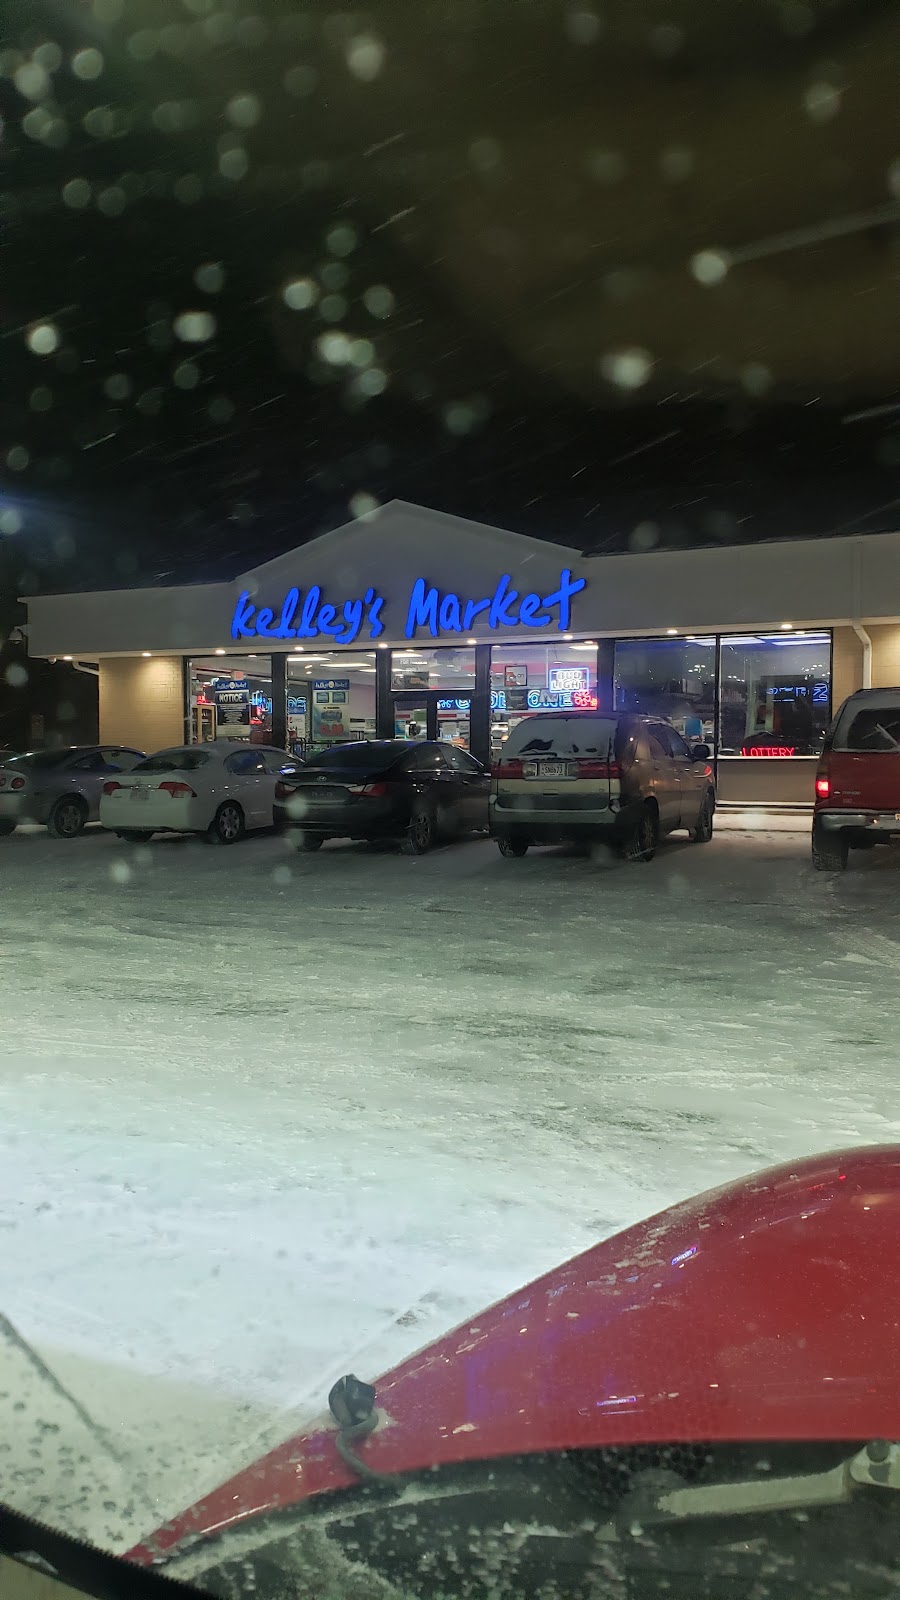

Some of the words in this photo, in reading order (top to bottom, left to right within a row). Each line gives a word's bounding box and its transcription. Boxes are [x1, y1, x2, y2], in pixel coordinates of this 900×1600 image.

[405, 568, 586, 639] Market
[551, 679, 587, 690] LIGHT
[219, 693, 243, 703] NOTICE
[742, 747, 795, 756] LOTTERY
